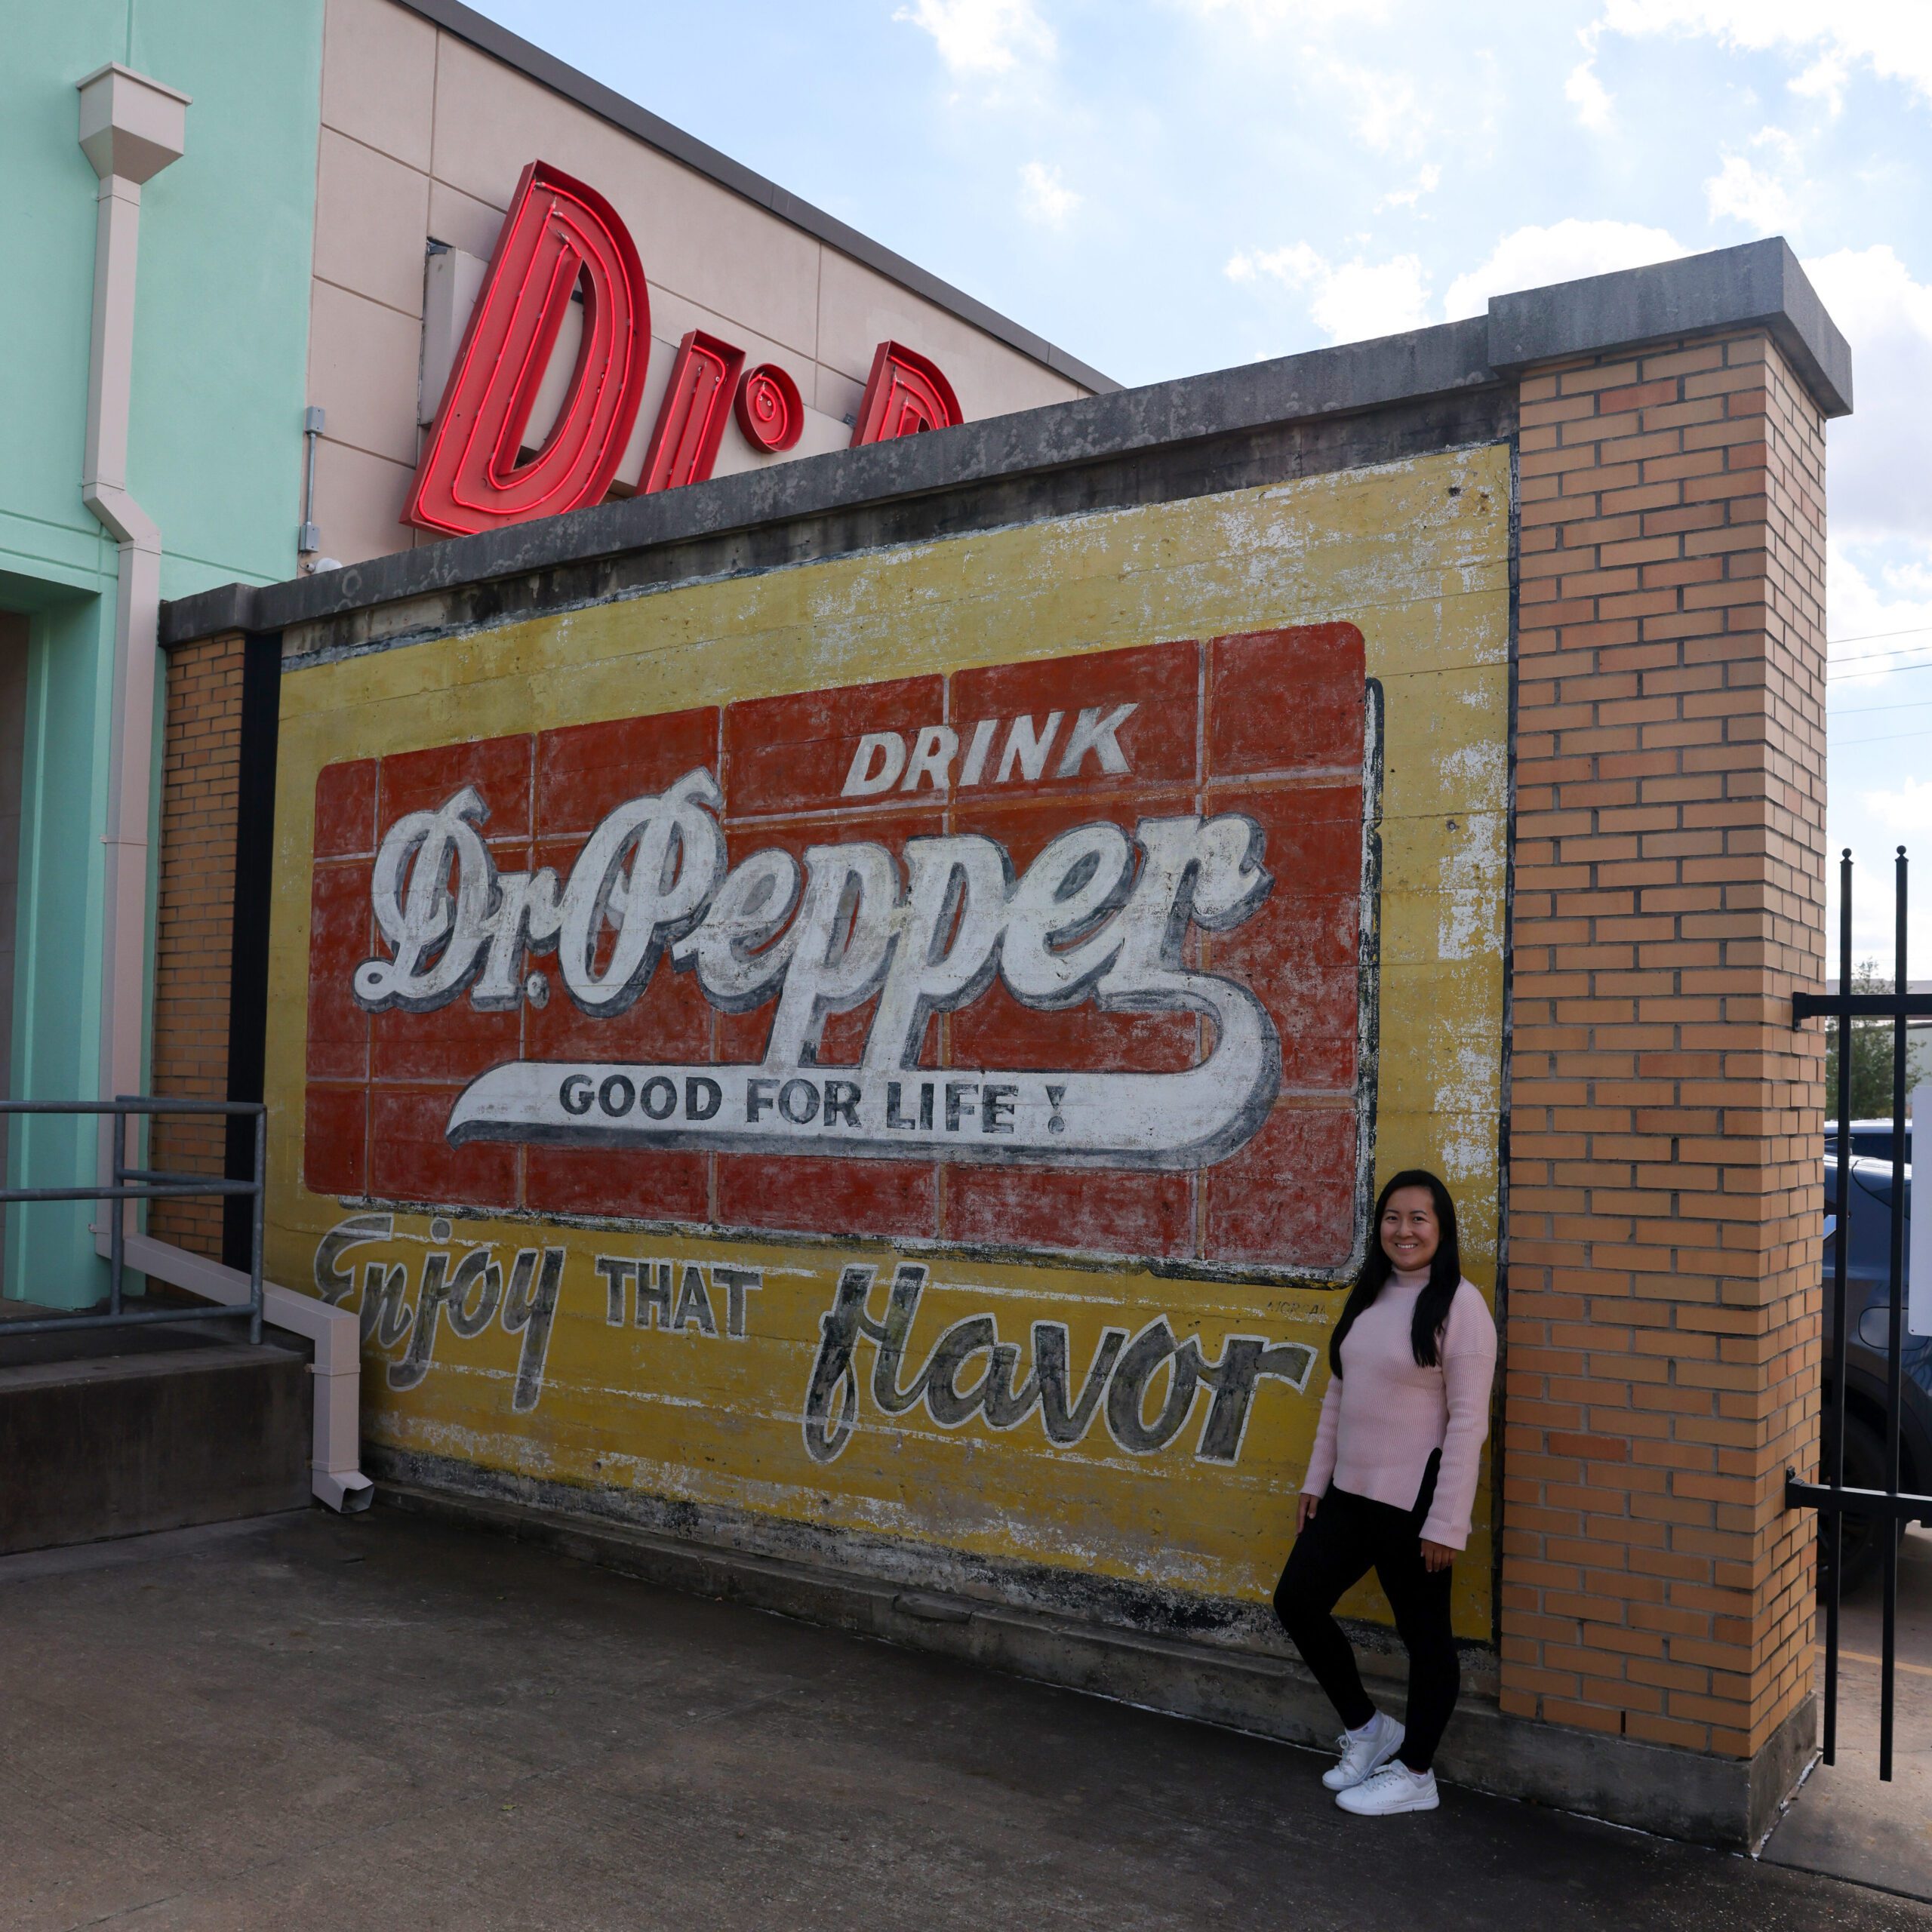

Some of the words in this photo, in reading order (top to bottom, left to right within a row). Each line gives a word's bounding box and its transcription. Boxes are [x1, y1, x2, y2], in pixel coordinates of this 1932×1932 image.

[840, 703, 1138, 797] DRINK
[559, 1074, 722, 1120] GOOD
[746, 1077, 862, 1128] FOR
[312, 1213, 567, 1414] Enjoy
[595, 1253, 763, 1340] THAT
